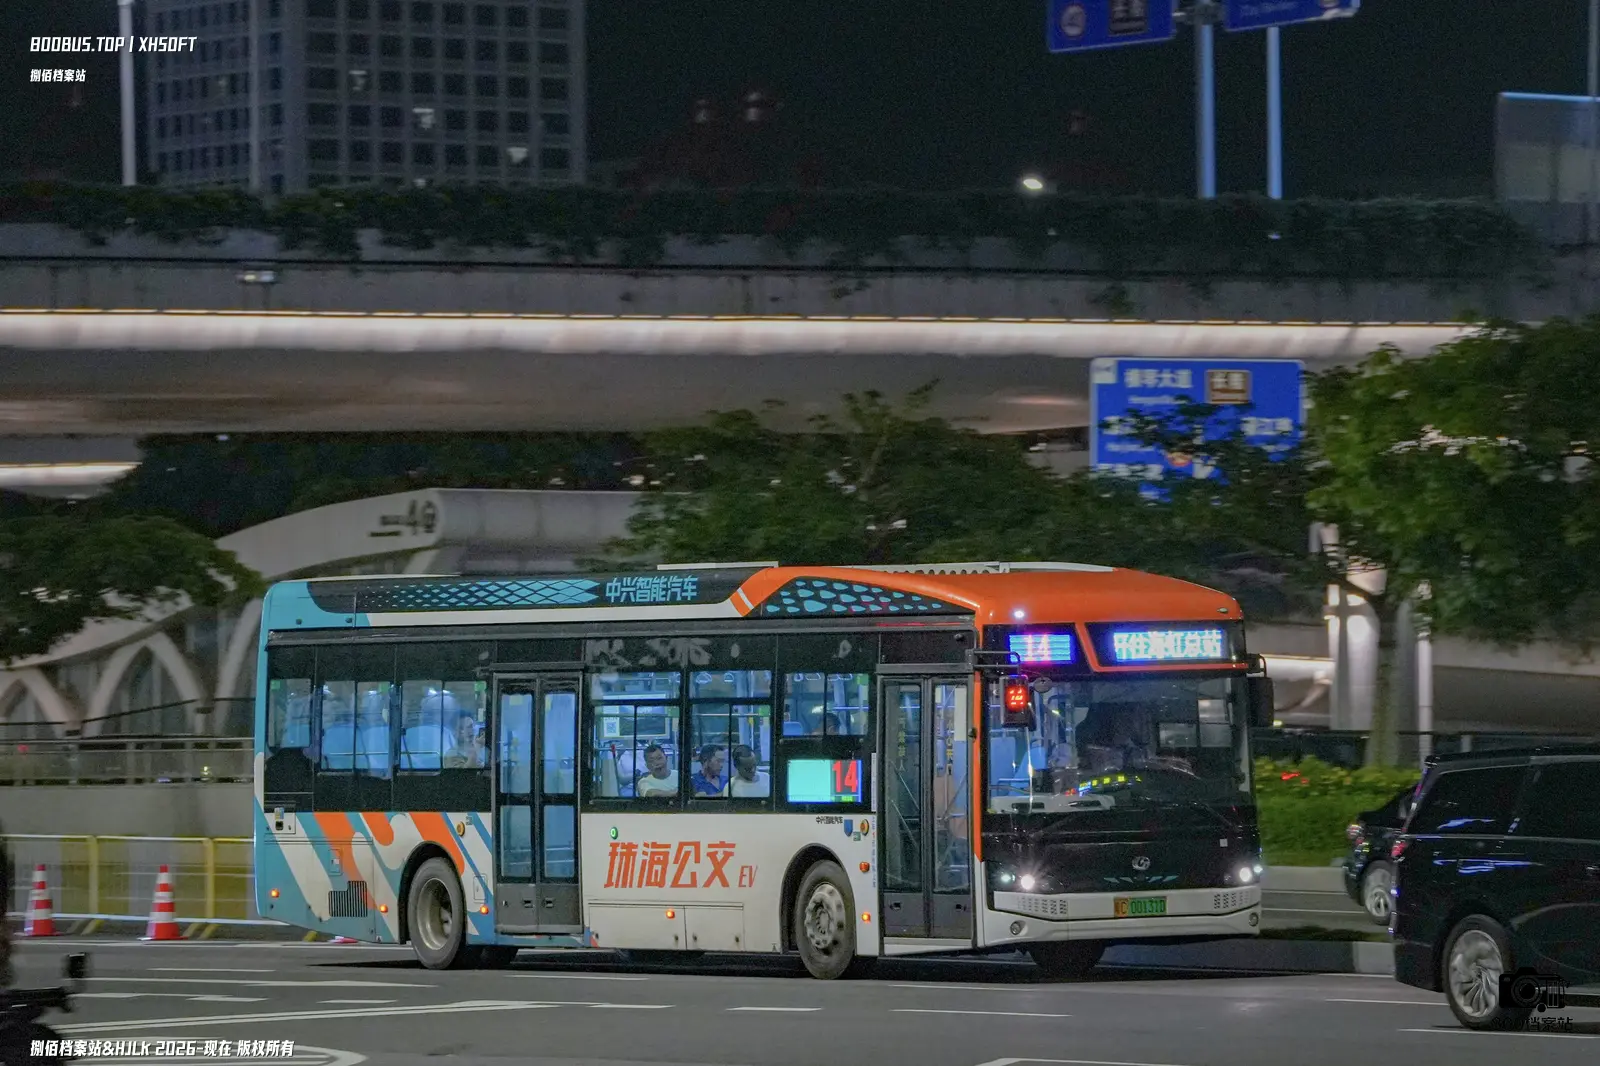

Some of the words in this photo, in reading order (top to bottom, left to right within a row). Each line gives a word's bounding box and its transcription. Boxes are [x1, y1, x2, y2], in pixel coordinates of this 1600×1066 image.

[605, 575, 698, 602] 中兴智能汽车
[1025, 633, 1050, 662] 14
[832, 760, 858, 793] 14
[604, 841, 736, 888] 珠海公交
[738, 865, 758, 888] EV
